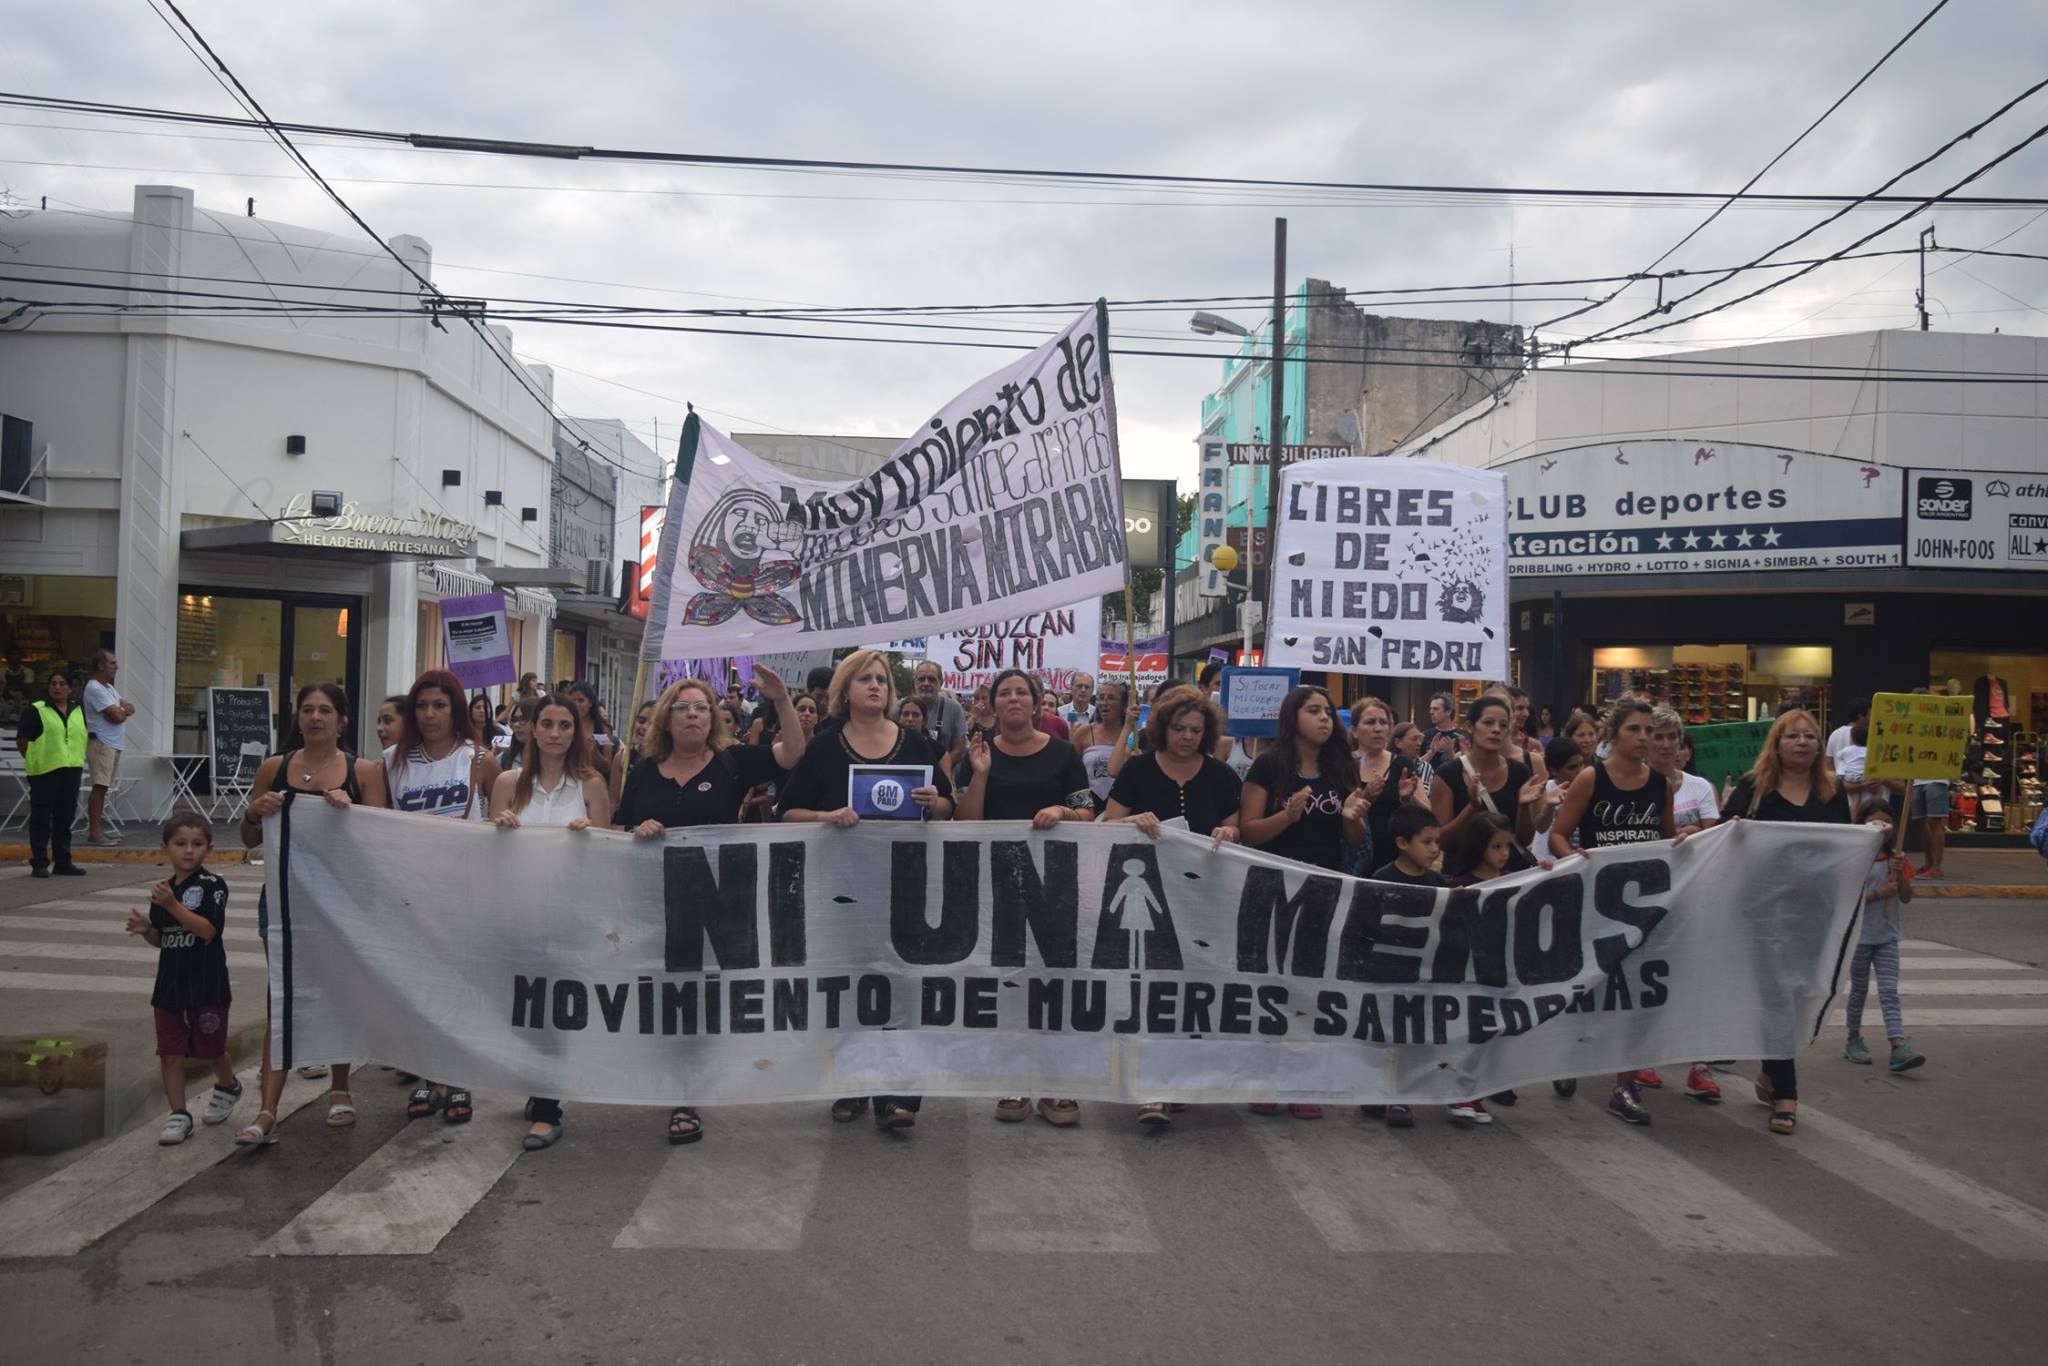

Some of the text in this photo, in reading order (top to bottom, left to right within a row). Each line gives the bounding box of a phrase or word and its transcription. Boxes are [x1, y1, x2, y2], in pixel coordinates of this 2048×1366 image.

[1055, 332, 1101, 413] de
[1289, 484, 1454, 527] LIBRES
[1615, 485, 1787, 521] deportes
[303, 534, 453, 556] HELADERIA ARTESANAL
[1335, 532, 1390, 571] DE
[1915, 539, 1995, 560] JOHN FOOS
[2011, 535, 2031, 555] ALL
[797, 522, 984, 633] MINERVA
[1509, 563, 1573, 574] DRIBBLING
[1588, 561, 1631, 572] HYDRO
[1647, 560, 1688, 571] LOTTO
[1704, 558, 1750, 569] SIGNIA
[1764, 555, 1818, 567] SIMBRA
[1836, 553, 1887, 565] SOUTH
[1290, 579, 1428, 620] MIEDO
[953, 638, 1044, 672] SIN MI
[1312, 636, 1483, 672] SAN PEDRO
[878, 785, 898, 798] 8M
[664, 840, 1672, 988] NI UNA MENOS
[920, 976, 999, 1029] DE
[1028, 973, 1288, 1034] MUJERES
